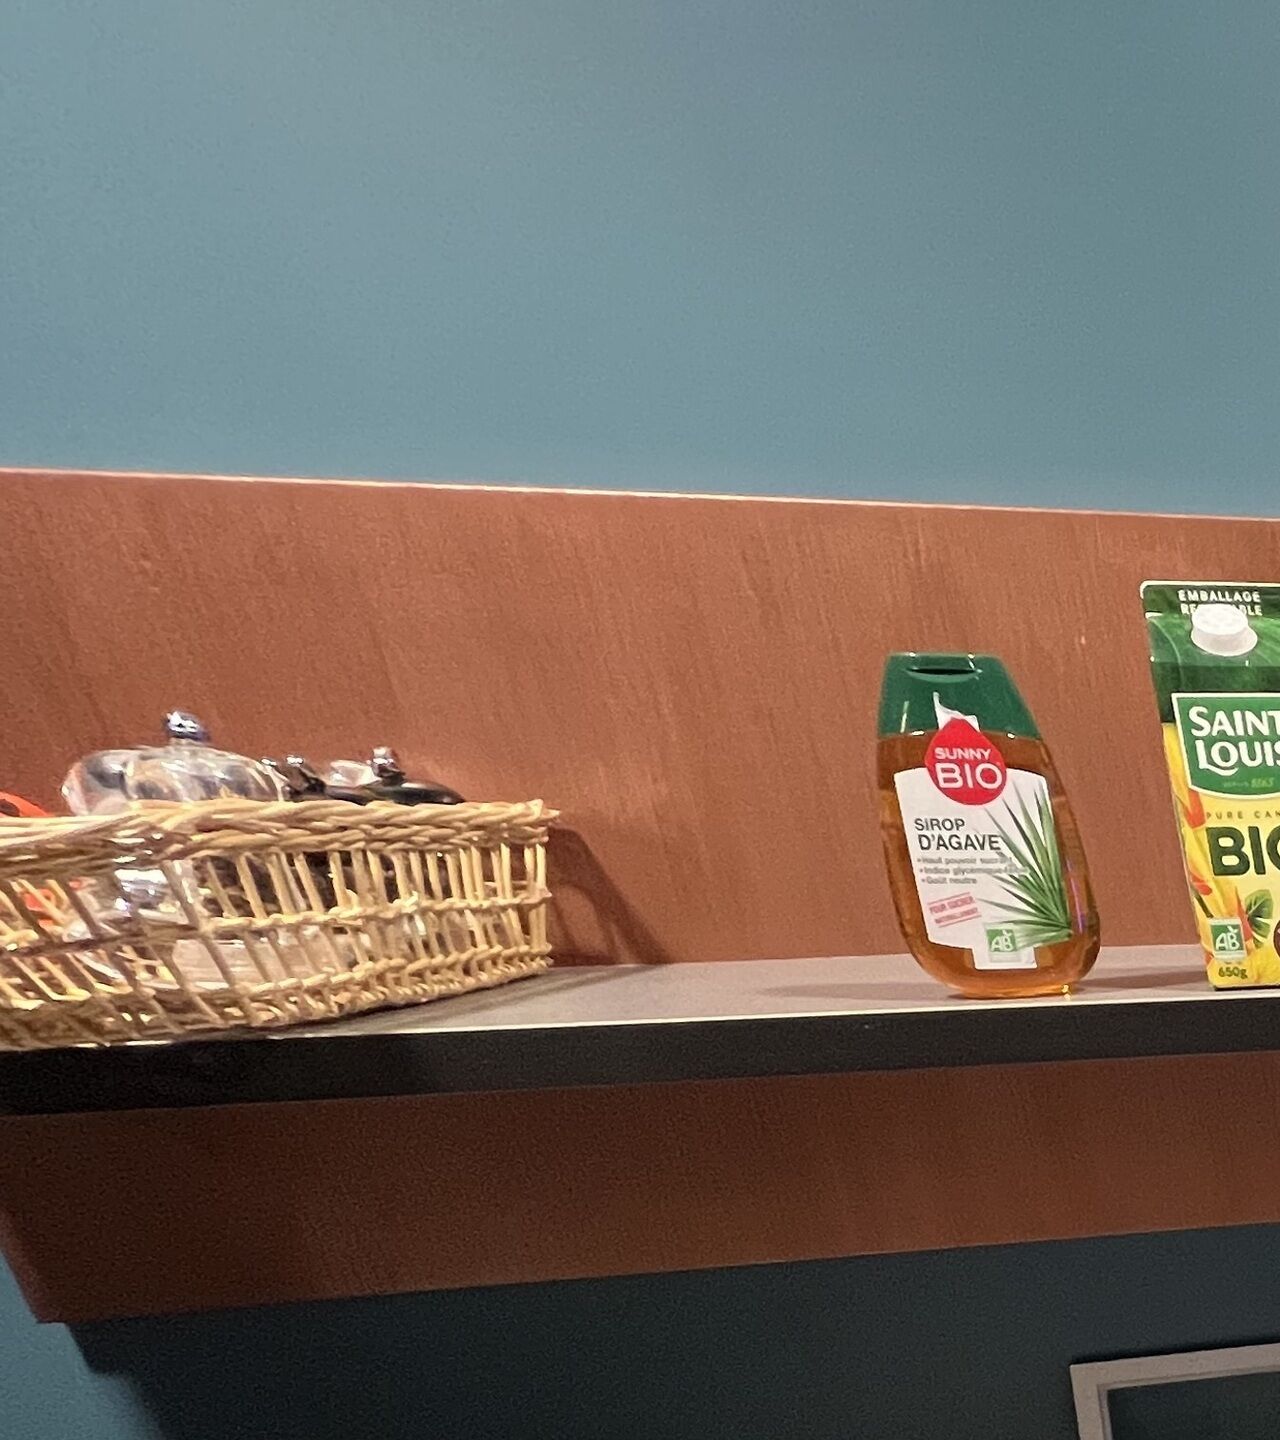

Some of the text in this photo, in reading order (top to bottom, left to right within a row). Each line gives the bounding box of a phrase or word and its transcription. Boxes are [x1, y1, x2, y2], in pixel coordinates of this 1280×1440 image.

[1178, 590, 1261, 603] EMBALLAGE
[934, 747, 991, 760] SUNNY
[935, 763, 1003, 790] BIO
[1206, 810, 1244, 820] PURE
[914, 818, 965, 831] SIROP
[918, 834, 1001, 851] D'AGAVE
